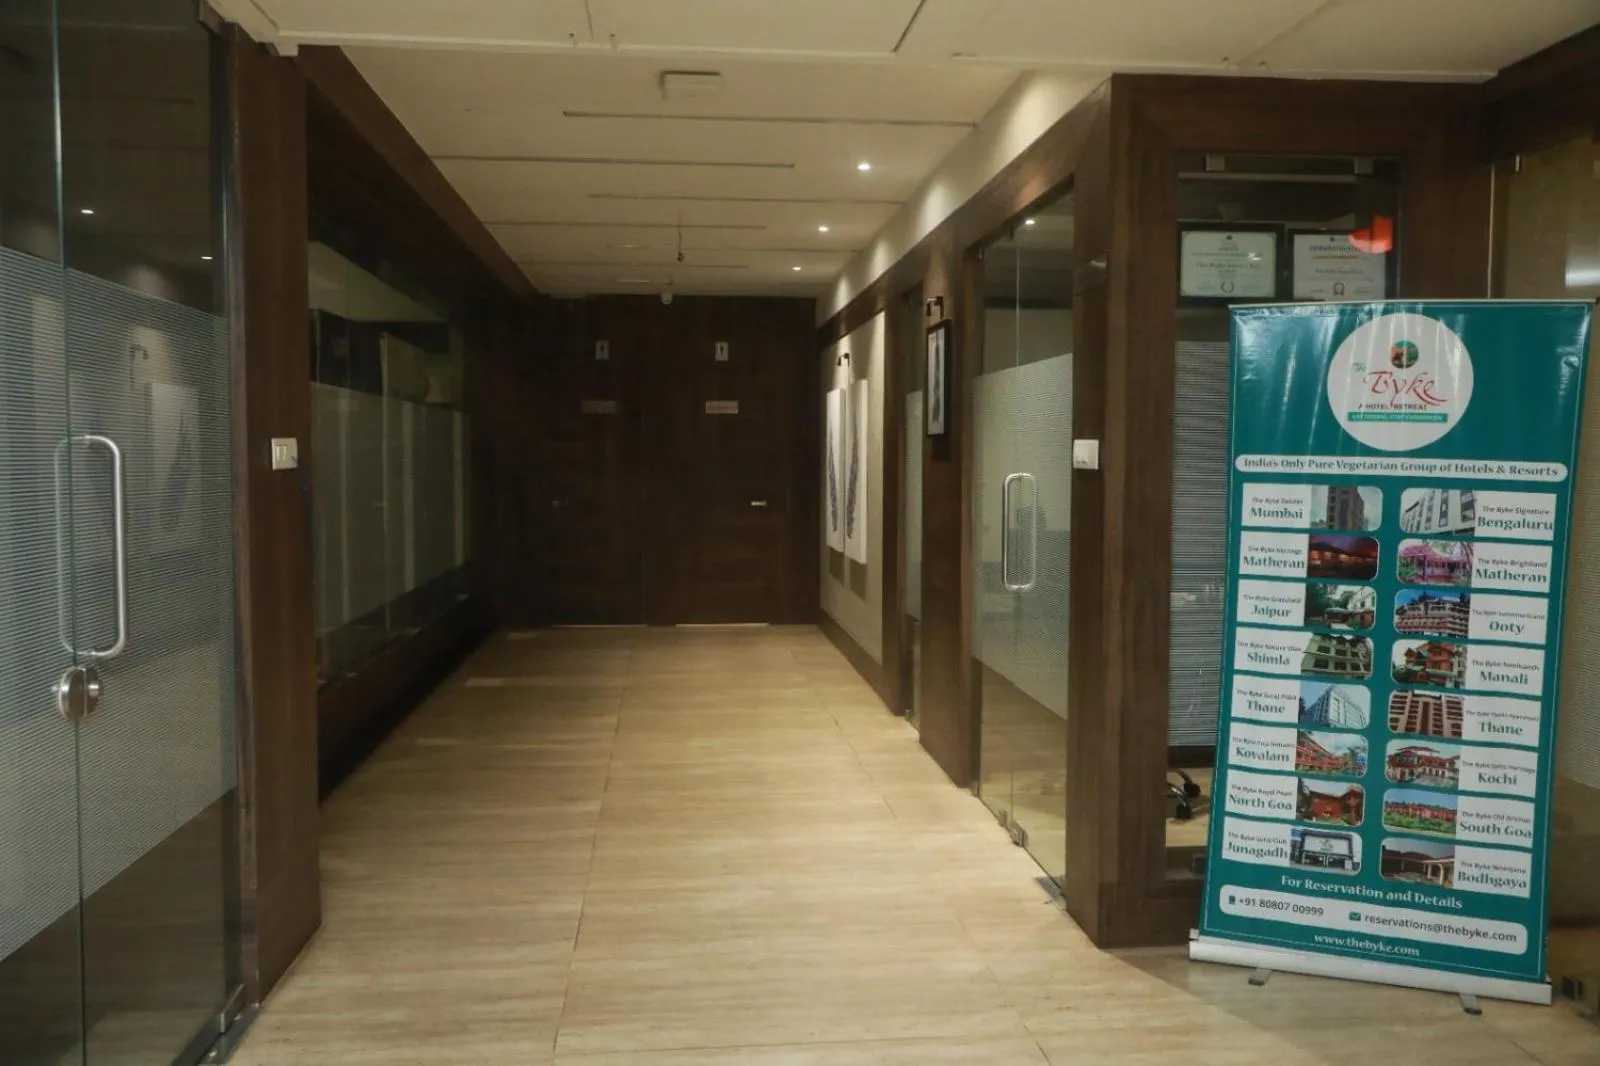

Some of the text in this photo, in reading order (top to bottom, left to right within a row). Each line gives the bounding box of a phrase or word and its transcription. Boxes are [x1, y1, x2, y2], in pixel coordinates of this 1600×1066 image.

[1367, 370, 1448, 408] Byke
[1244, 457, 1559, 477] India's Only Pure Vegetarian Group of Hotels & Resorts
[1250, 507, 1303, 519] Mumbai
[1496, 506, 1513, 514] Byke
[1515, 507, 1550, 515] Signature
[1477, 516, 1553, 530] Bengaluru
[1243, 555, 1305, 568] Matheran
[1476, 568, 1547, 583] Matheran
[1251, 604, 1292, 618] Jaipur
[1489, 620, 1525, 635] Ooty
[1247, 651, 1290, 665] Shimla
[1480, 670, 1528, 685] Manali
[1247, 700, 1285, 713] Thane
[1479, 721, 1523, 735] Thane
[1236, 747, 1289, 762] Kovalam
[1478, 771, 1517, 785] Kochi
[1230, 794, 1293, 810] North Goa
[1460, 821, 1532, 838] South Goa
[1225, 841, 1288, 858] Junagadh
[1458, 871, 1527, 888] Bodhgaya
[1281, 875, 1463, 909] For Reservation and Details
[1239, 897, 1324, 916] +91 80807 00999
[1364, 914, 1517, 942] reservations@thebyke.com
[1314, 934, 1420, 956] www.thebyke.com
